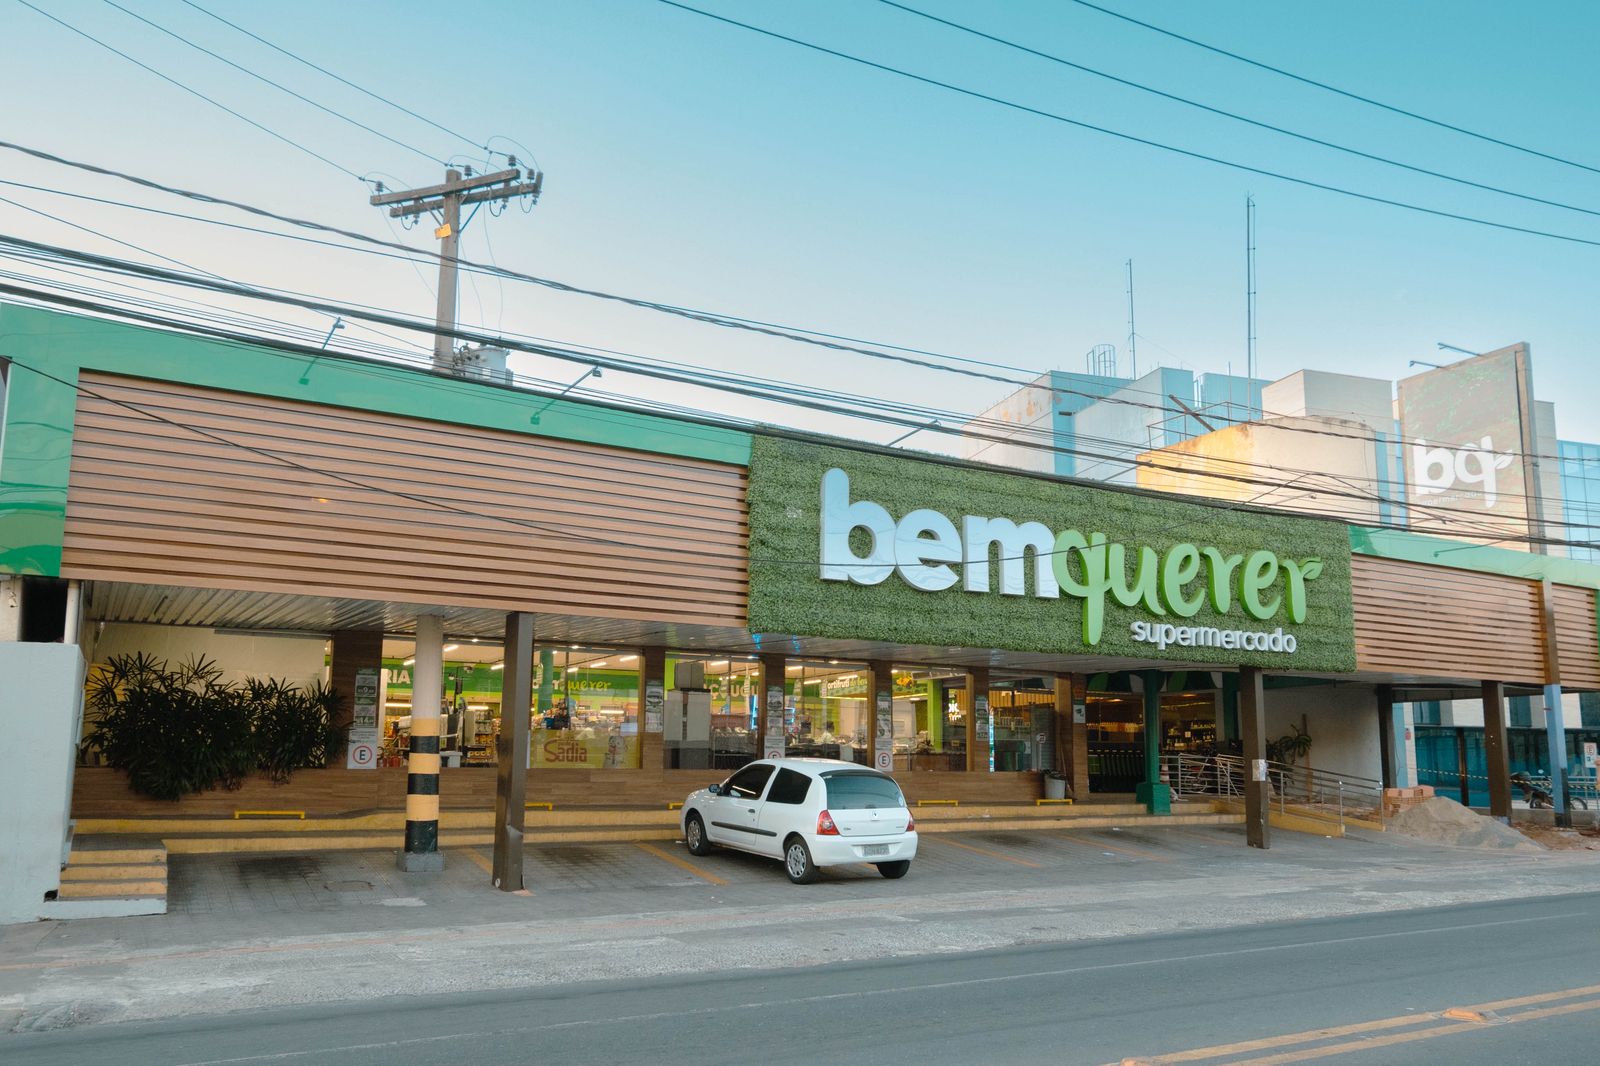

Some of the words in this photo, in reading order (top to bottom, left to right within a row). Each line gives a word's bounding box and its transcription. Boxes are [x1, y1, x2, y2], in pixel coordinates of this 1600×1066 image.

[1413, 435, 1498, 508] bq
[1130, 621, 1297, 653] supermercado
[359, 749, 366, 760] E
[543, 738, 588, 763] Sadia
[881, 755, 887, 765] E
